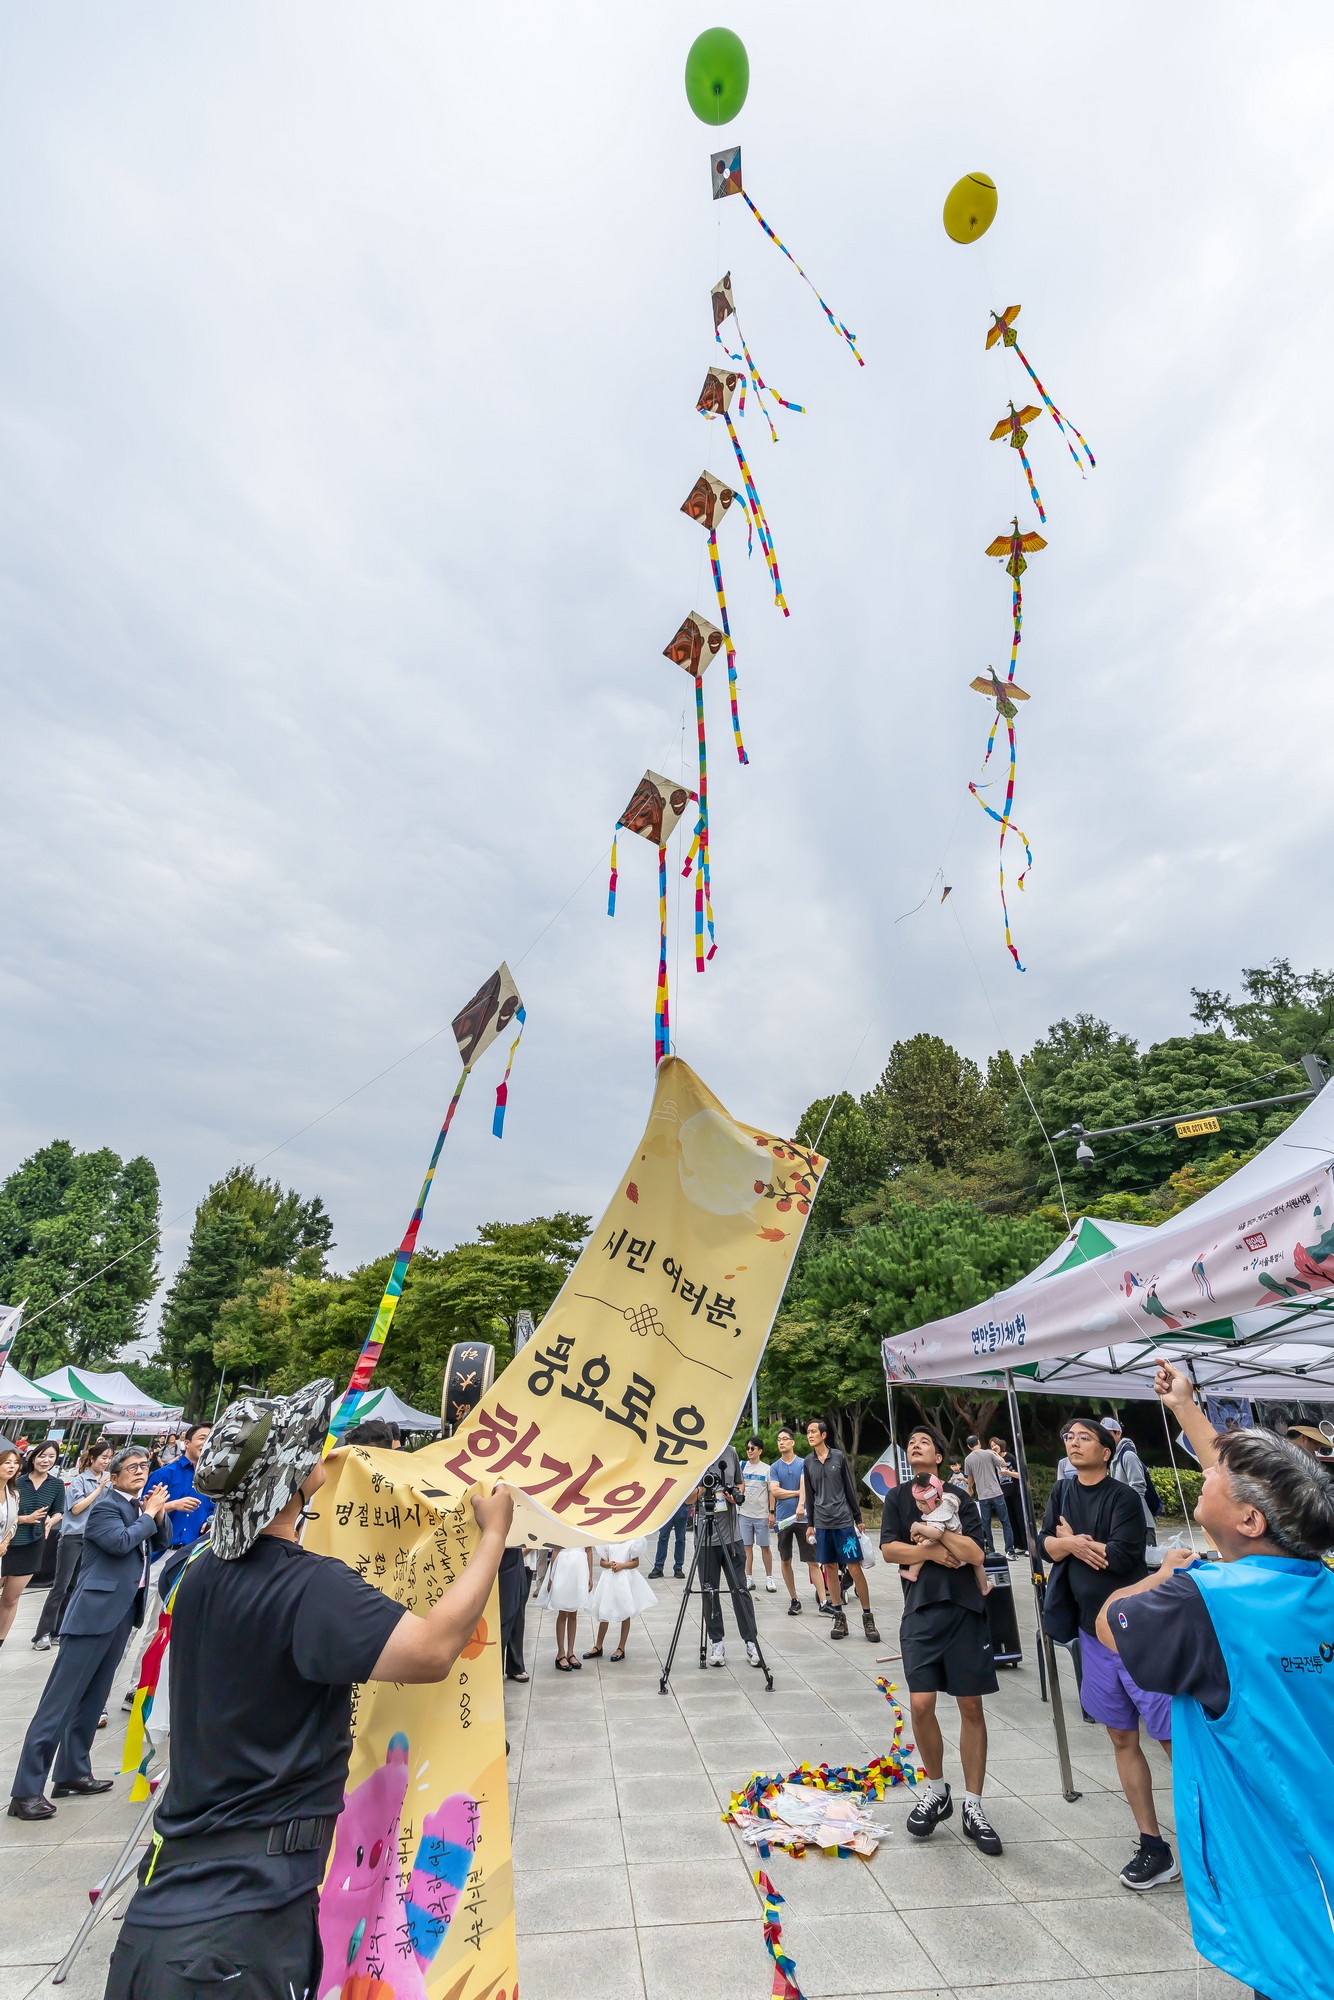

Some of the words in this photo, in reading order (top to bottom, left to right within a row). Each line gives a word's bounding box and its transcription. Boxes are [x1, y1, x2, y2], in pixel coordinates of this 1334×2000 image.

[1191, 1123, 1204, 1133] CCTV
[602, 1229, 656, 1274] 시민
[661, 1256, 742, 1338] 여러분,
[528, 1334, 708, 1465] 풍요로운
[445, 1402, 677, 1534] 한가위
[1280, 1656, 1323, 1674] 한국전통
